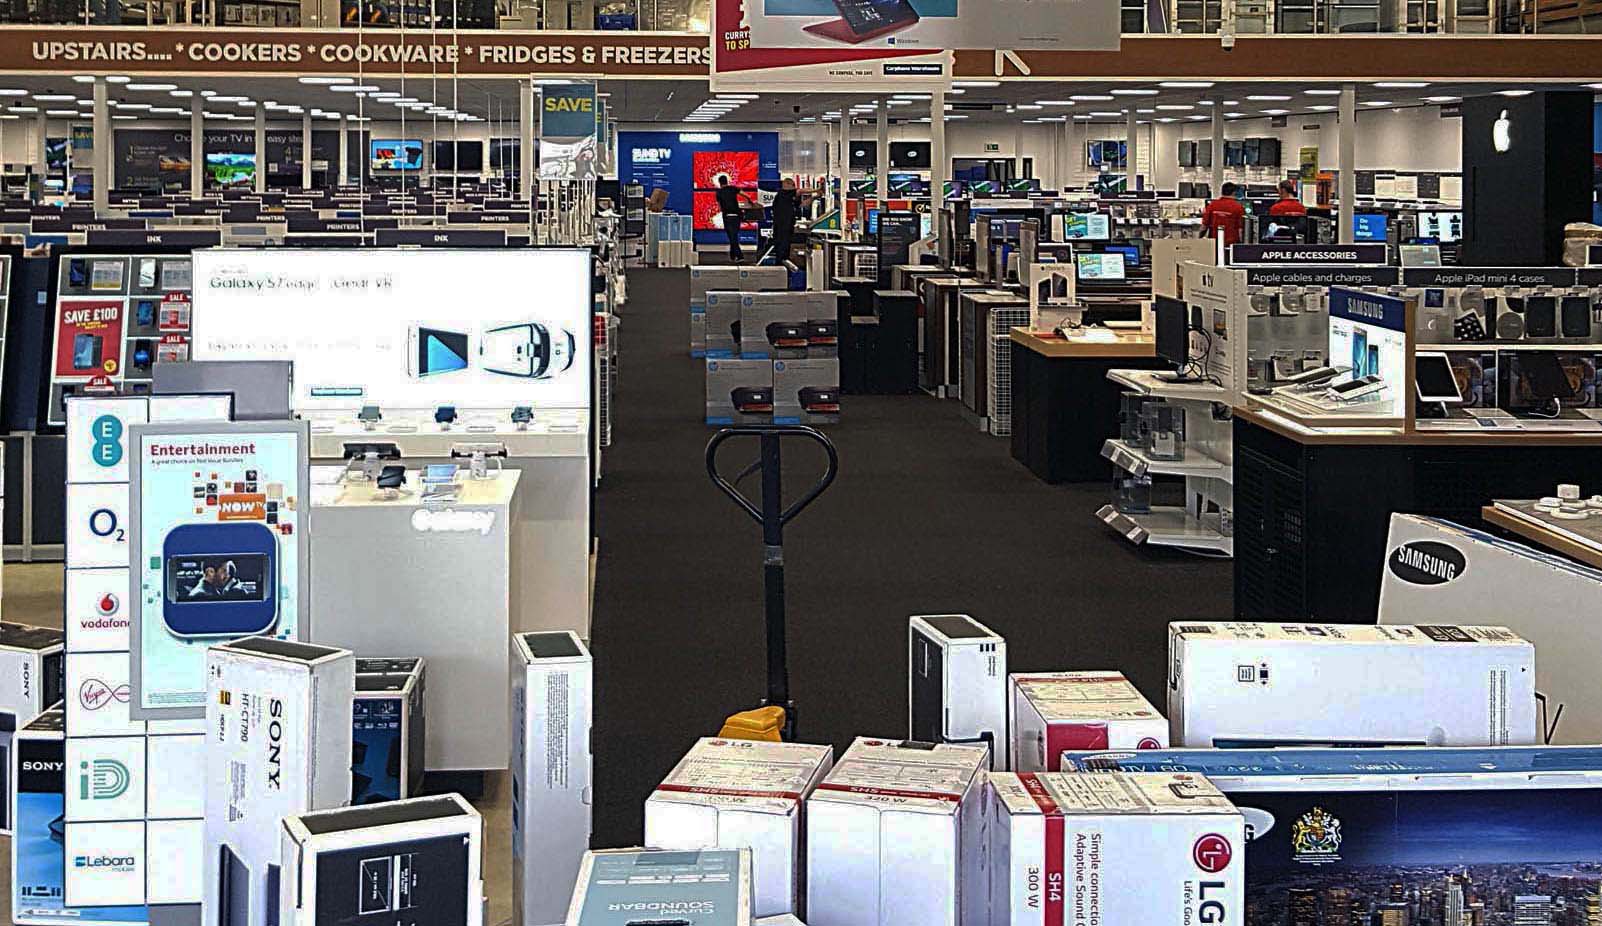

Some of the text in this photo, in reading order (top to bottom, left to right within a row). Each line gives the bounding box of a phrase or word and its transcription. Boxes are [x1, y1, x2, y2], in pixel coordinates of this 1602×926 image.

[188, 43, 302, 61] COOKERS
[320, 44, 459, 63] COOKWARE
[479, 46, 577, 64] FRIDGES
[582, 46, 596, 64] &
[545, 98, 592, 112] SAVE
[147, 235, 162, 243] INK
[1262, 251, 1357, 259] APPLE ACCESSORIES
[209, 277, 264, 291] Galaxy
[1253, 273, 1373, 283] Apple cables and charges
[1435, 274, 1463, 283] Apple
[1465, 274, 1486, 282] iPad
[1488, 274, 1507, 282] mini
[1509, 274, 1517, 282] 4
[64, 307, 118, 324] SAVE £100
[1347, 297, 1384, 320] SAMSUNG
[151, 443, 256, 456] Entertainment
[221, 503, 253, 512] NOW
[1398, 545, 1456, 580] SAMSUNG
[241, 692, 249, 742] HT-CT790
[268, 698, 282, 790] SONY
[22, 761, 64, 771] SONY
[1089, 833, 1102, 870] Simple
[87, 856, 135, 867] Lebara
[1073, 833, 1087, 919] Adaptive Sound
[1028, 867, 1039, 908] 300 W
[1049, 872, 1062, 902] SH4
[608, 900, 714, 911] SOUNDBAR
[1199, 881, 1226, 924] LG
[660, 908, 714, 916] Curved
